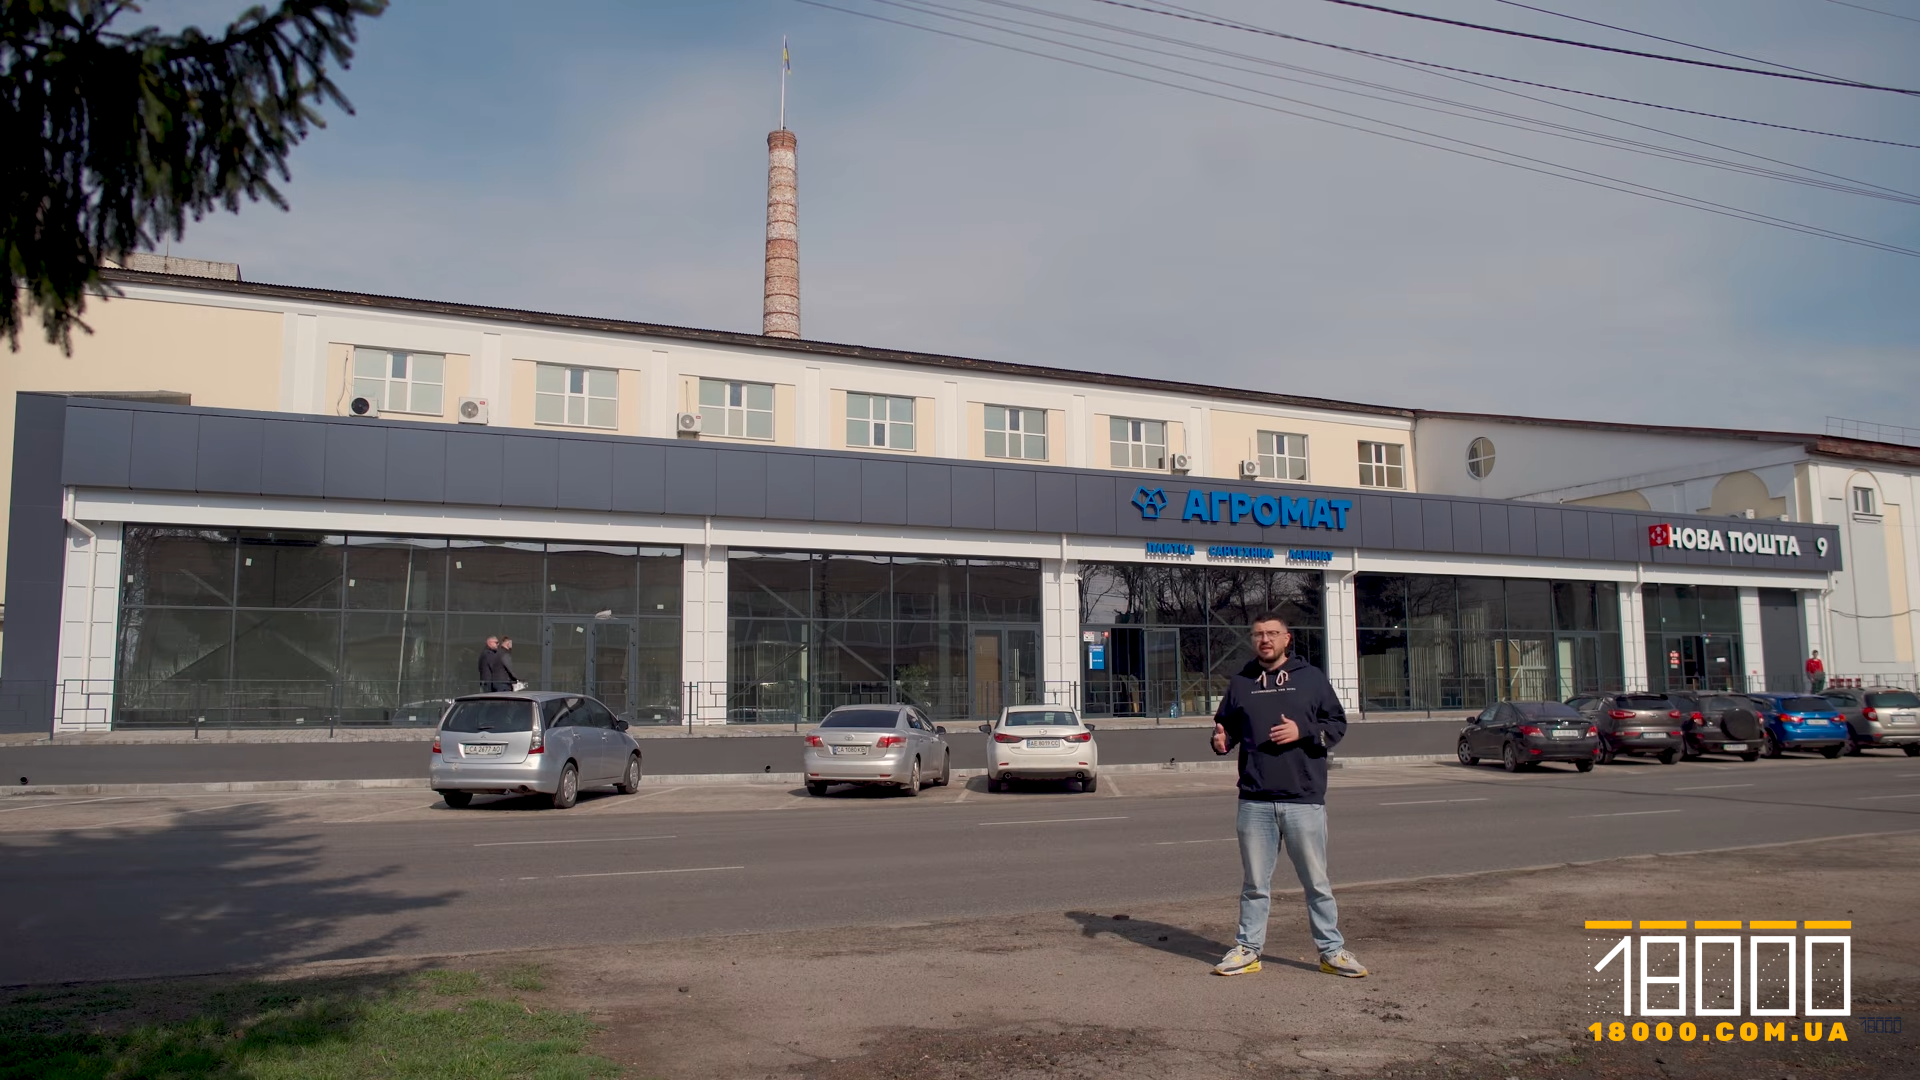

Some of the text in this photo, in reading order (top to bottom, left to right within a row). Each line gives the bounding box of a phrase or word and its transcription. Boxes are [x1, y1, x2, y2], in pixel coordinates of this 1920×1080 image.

[1182, 489, 1353, 529] АГРОМАТ
[1146, 542, 1333, 561] ПЛИТКА САНТЕХНІКА ЛАМІНАТ
[1668, 526, 1828, 557] НОВА ПОШТА 9
